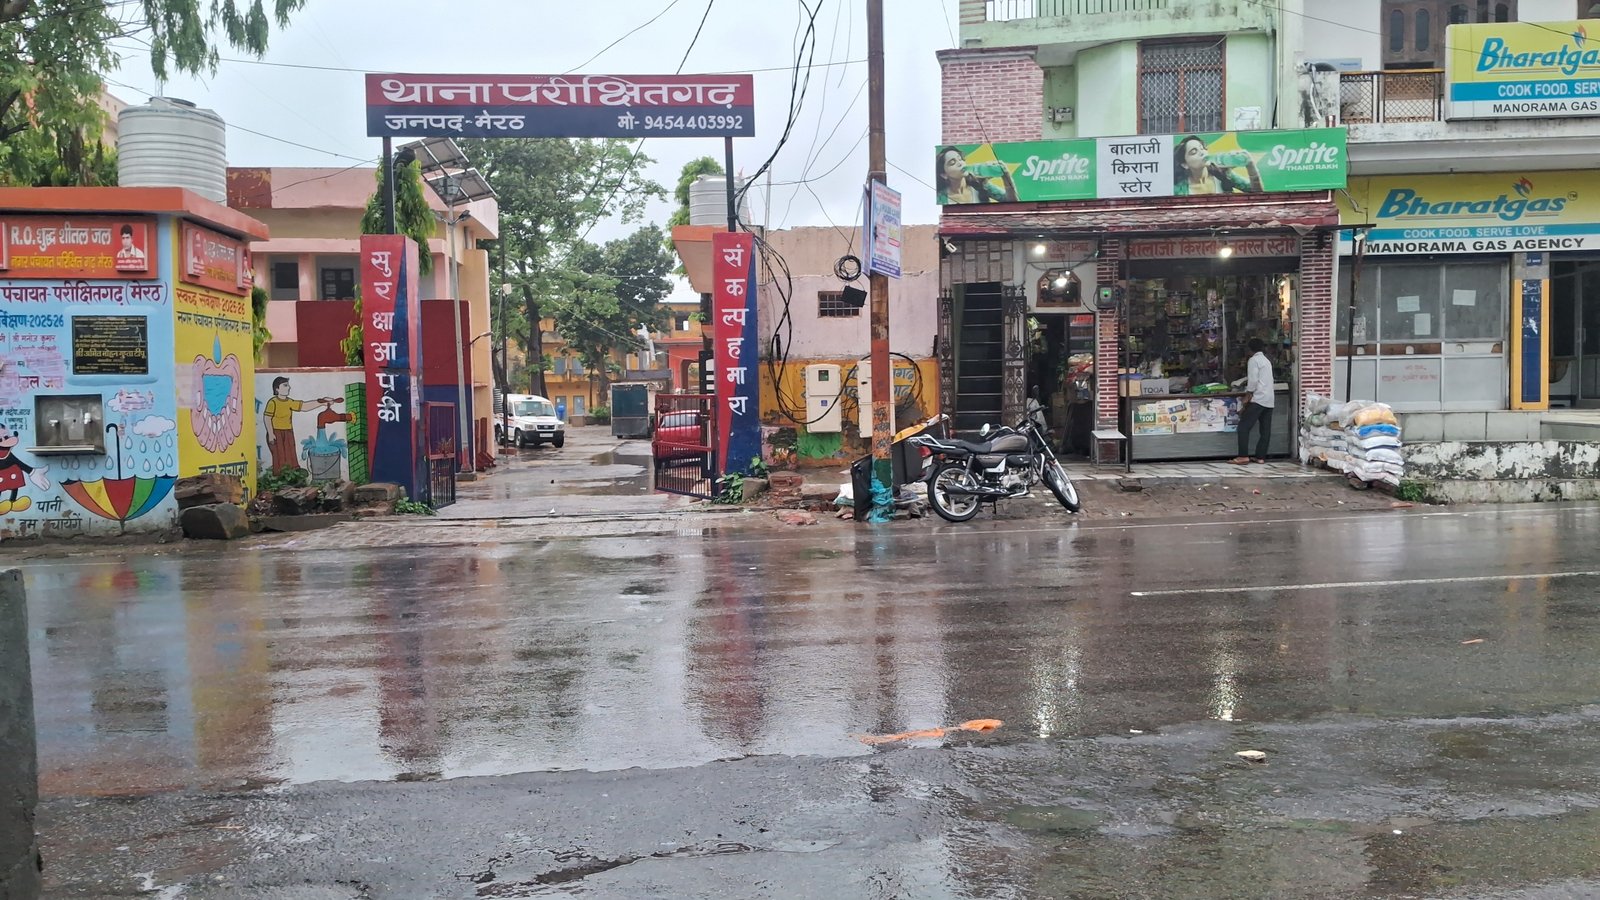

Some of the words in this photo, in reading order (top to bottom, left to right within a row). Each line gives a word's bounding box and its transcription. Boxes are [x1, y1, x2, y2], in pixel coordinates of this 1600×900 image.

[1476, 36, 1600, 76] Bharatga
[380, 78, 494, 104] थाना
[1498, 84, 1531, 98] COOK
[1535, 83, 1571, 96] FOOD.
[1493, 102, 1567, 114] MANORAMA
[1571, 101, 1598, 111] GAS
[644, 114, 743, 131] 9454403992
[1109, 138, 1161, 155] बालाजी
[1267, 142, 1339, 170] Sprite
[1022, 153, 1090, 181] Sprite
[1111, 158, 1159, 175] किराना
[1119, 177, 1152, 194] स्टोर
[1376, 188, 1567, 221] Bharatgas
[59, 221, 89, 246] शीतल
[91, 228, 113, 246] जल
[1404, 230, 1437, 239] COOK
[1439, 229, 1473, 238] FOOD.
[1476, 228, 1513, 237] SERVE
[1515, 226, 1549, 236] LOVE.
[1220, 239, 1265, 255] नरल
[1366, 241, 1467, 254] MANORAMA
[1473, 240, 1508, 251] GAS
[1513, 238, 1585, 250] AGENCY
[36, 496, 63, 513] पानी
